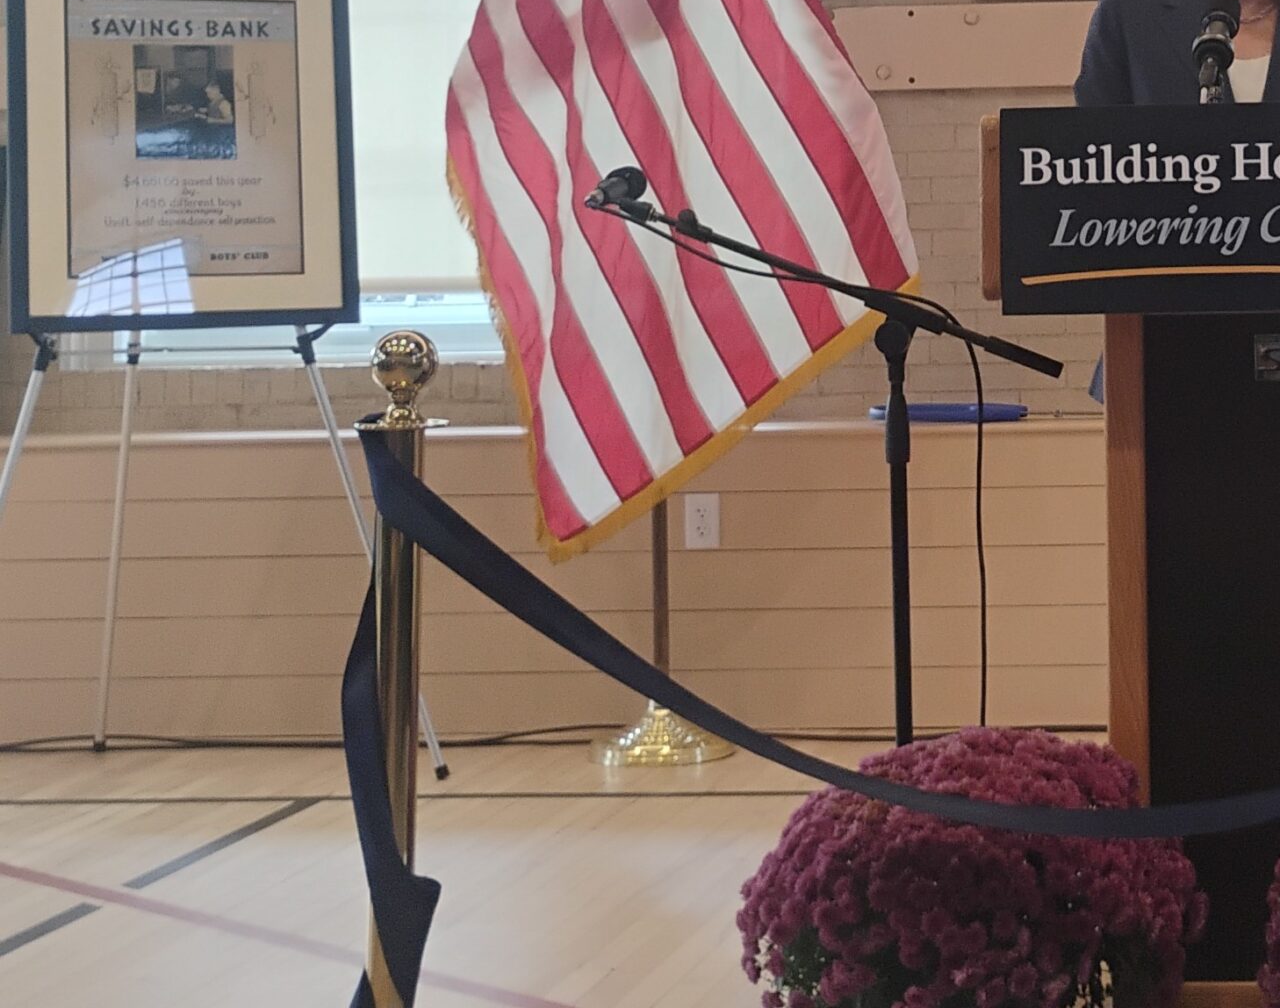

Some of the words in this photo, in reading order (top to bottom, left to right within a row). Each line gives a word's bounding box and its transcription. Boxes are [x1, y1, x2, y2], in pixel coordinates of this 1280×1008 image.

[91, 19, 193, 37] SAVINGS
[206, 20, 269, 38] BANK
[1018, 143, 1221, 193] Building
[1049, 204, 1251, 256] Lowering
